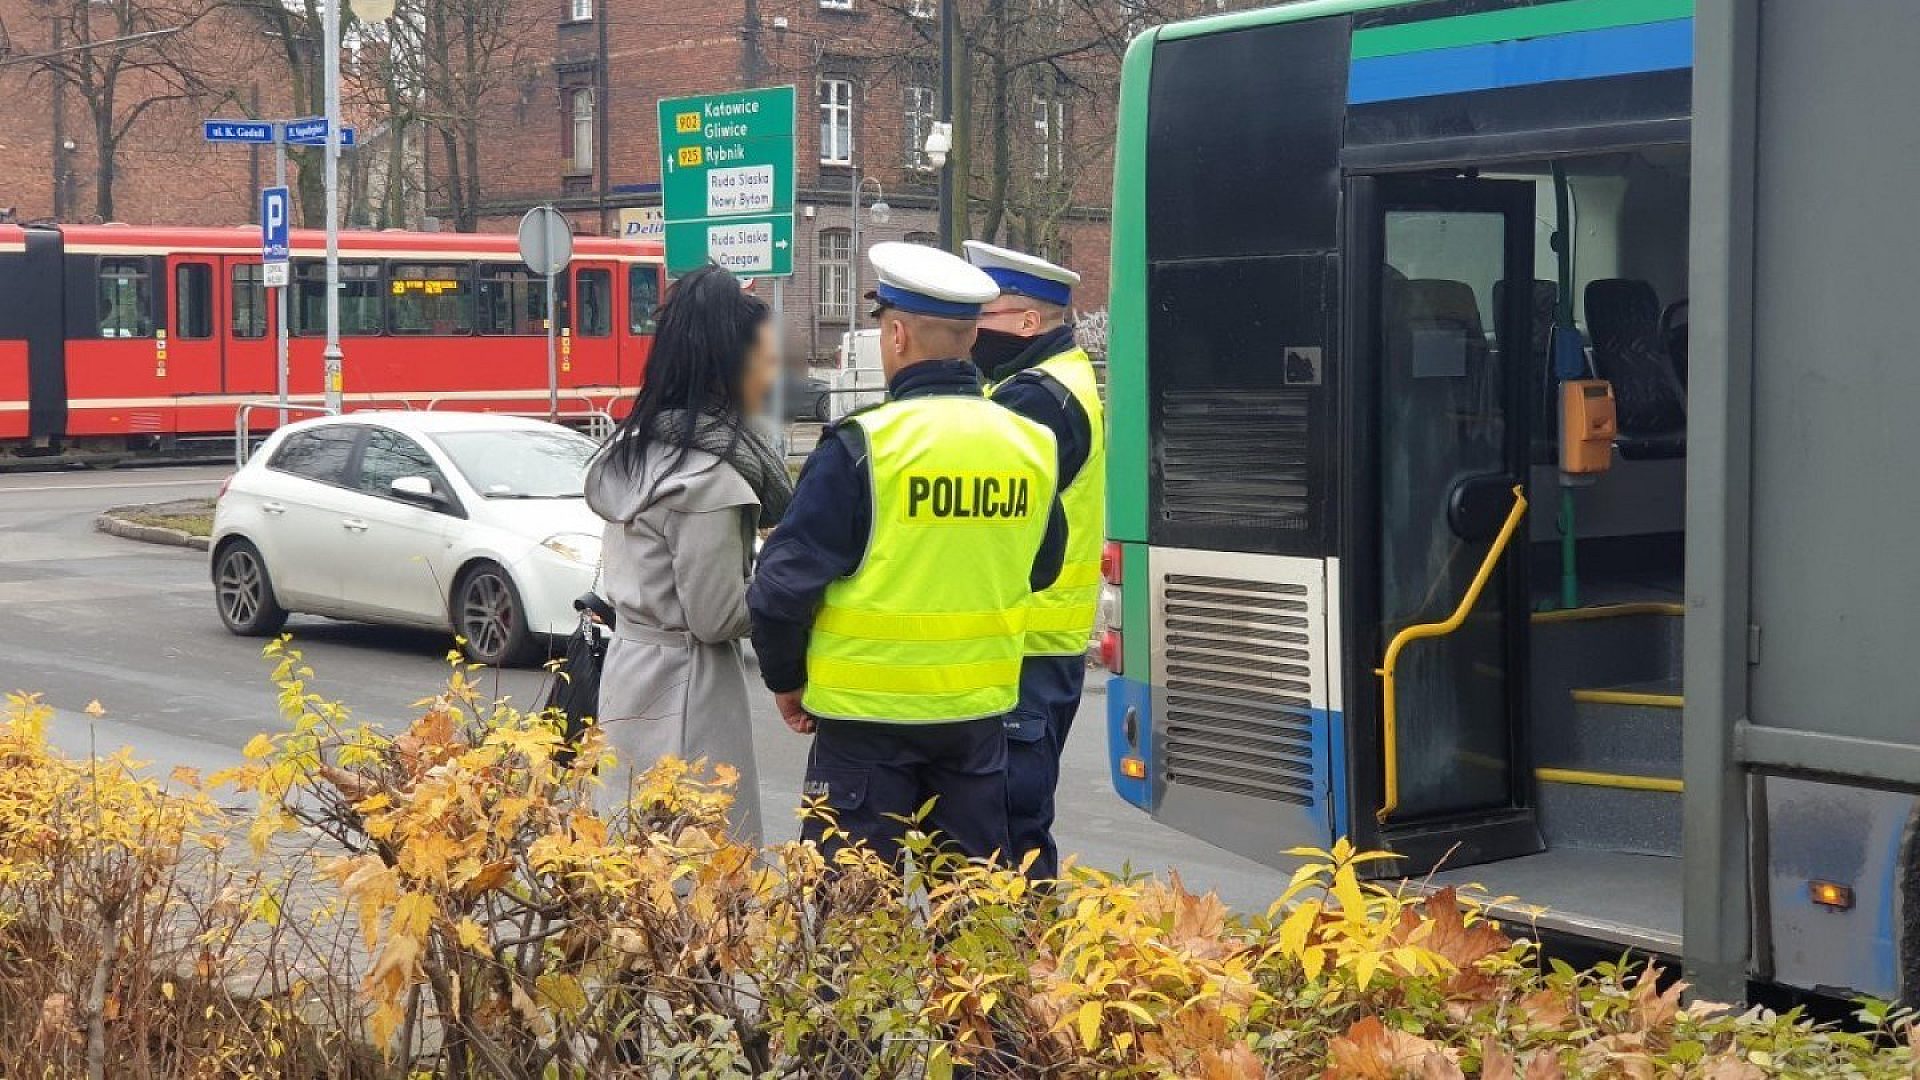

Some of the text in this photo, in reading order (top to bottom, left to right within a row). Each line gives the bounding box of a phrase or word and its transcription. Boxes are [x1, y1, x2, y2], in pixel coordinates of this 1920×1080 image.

[680, 98, 760, 129] 902 Katowice
[704, 121, 748, 138] Gliwice
[680, 143, 745, 165] 925 Rybnik
[711, 174, 736, 188] Ruda
[711, 192, 769, 208] Nowy Bytom
[268, 195, 282, 240] P
[711, 232, 736, 246] Ruda
[908, 475, 1028, 518] POLICJA
